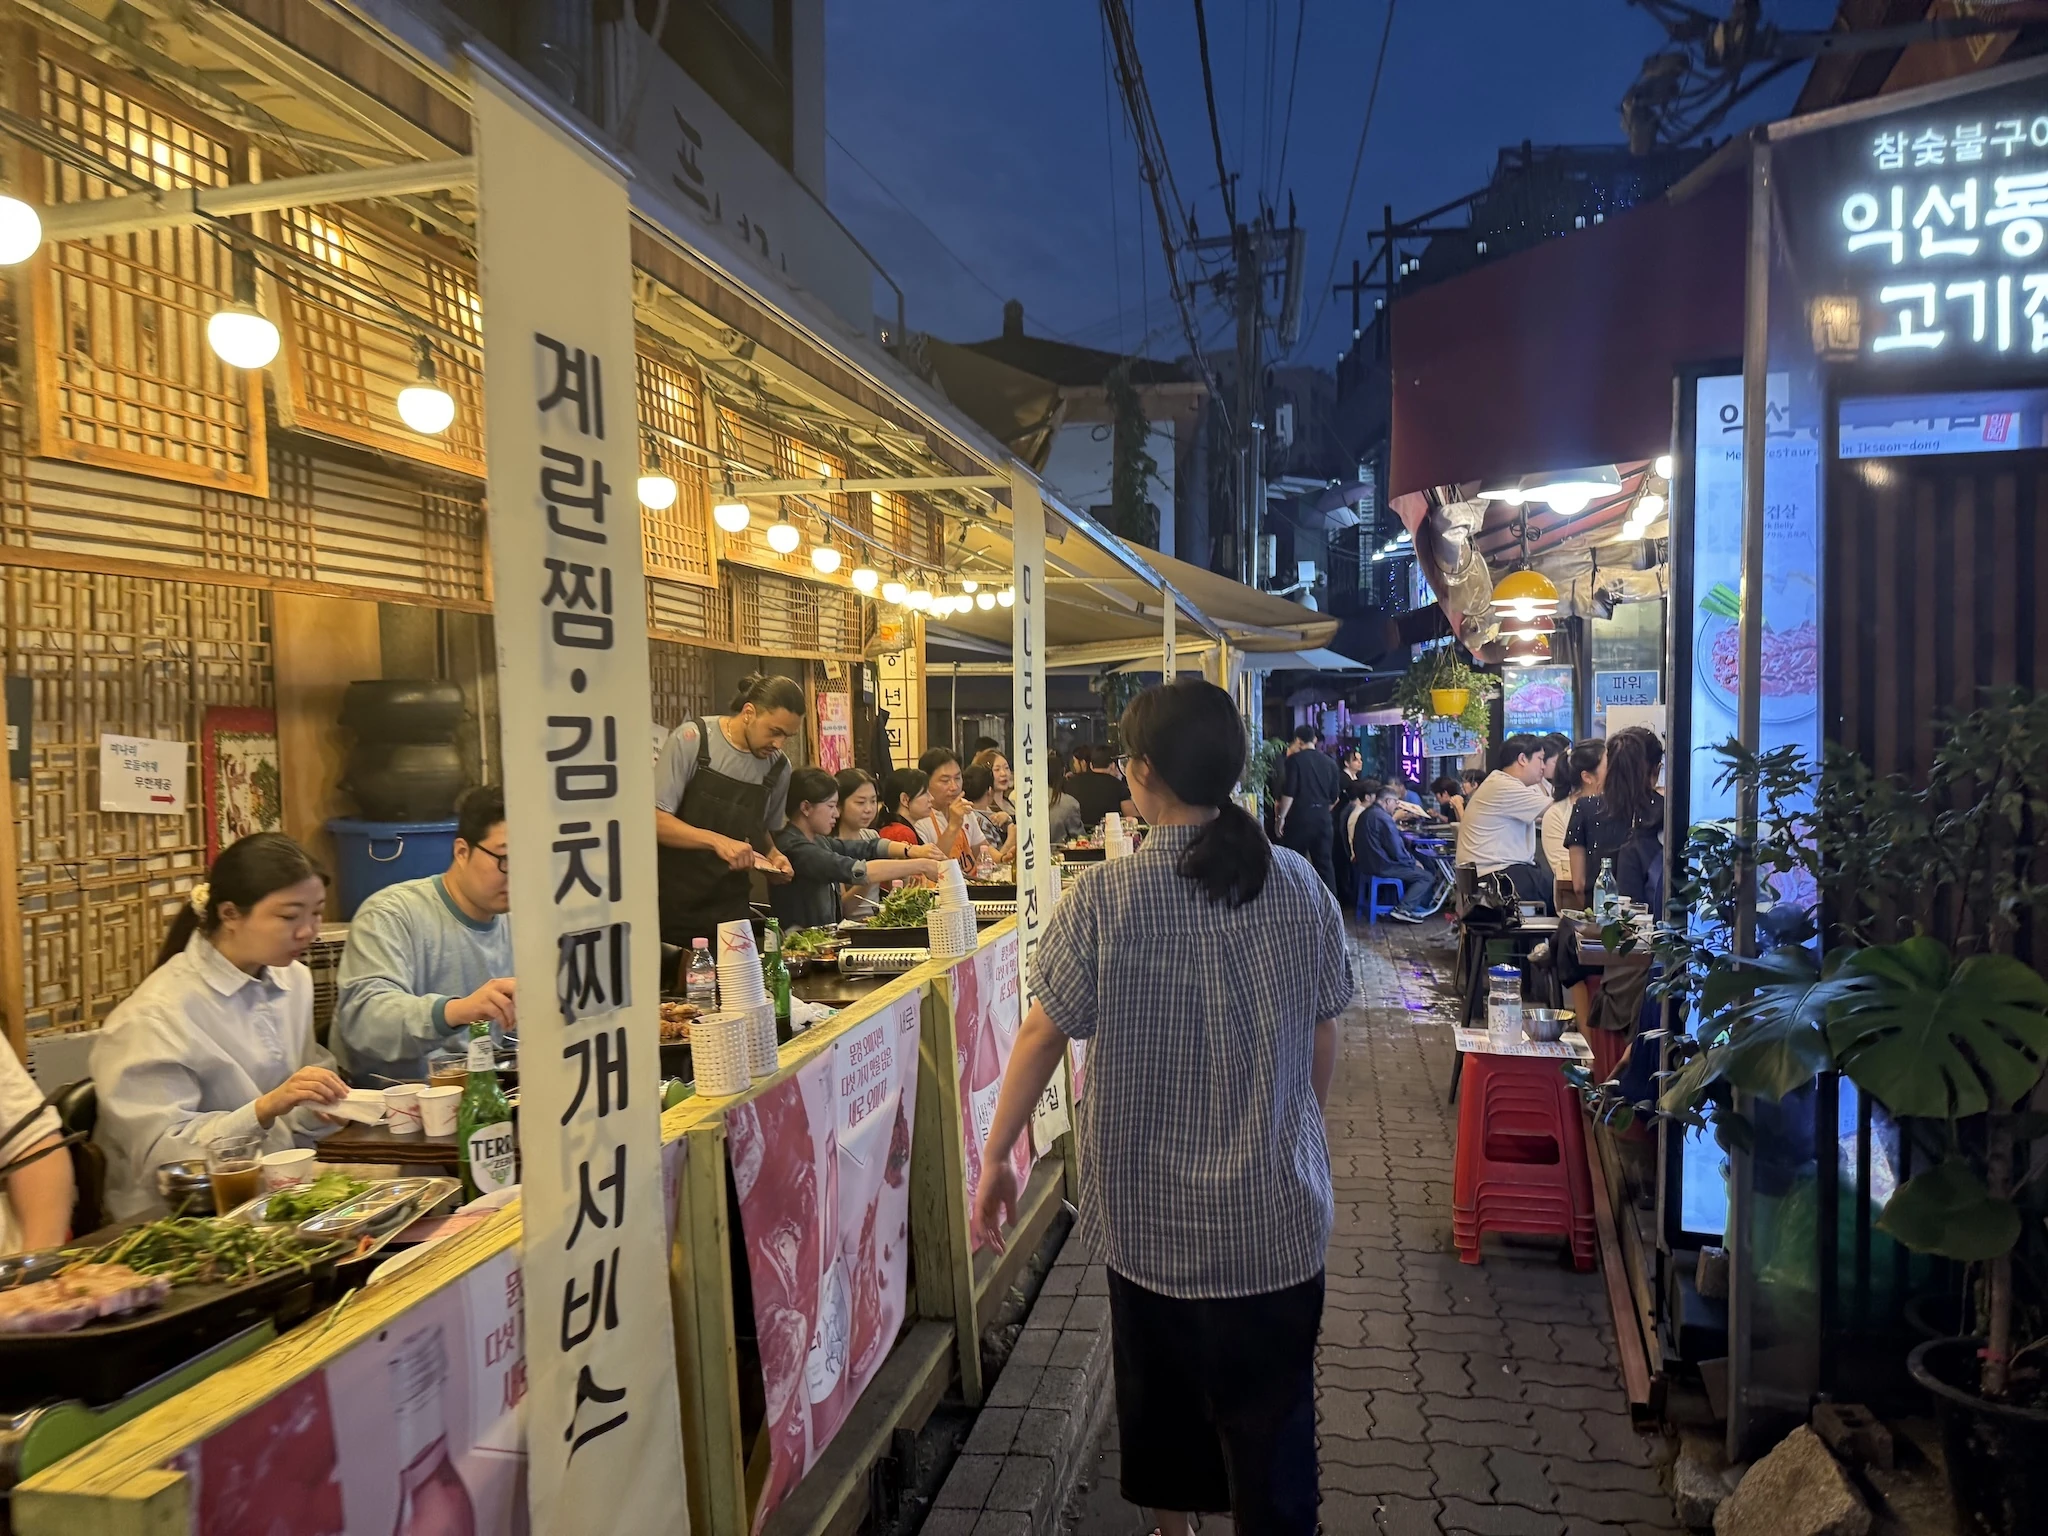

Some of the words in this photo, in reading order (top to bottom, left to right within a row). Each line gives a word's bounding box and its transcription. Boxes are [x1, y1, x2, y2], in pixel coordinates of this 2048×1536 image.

[1842, 171, 2048, 264] 익선동
[1858, 440, 1940, 453] Ikseon-dong
[1612, 675, 1642, 690] 파워
[110, 743, 138, 756] 미나리
[134, 776, 173, 791] 무한제공
[899, 1006, 914, 1036] 새로
[841, 1074, 856, 1096] 다섯
[857, 1065, 869, 1087] 가지
[848, 1095, 864, 1129] 새로
[866, 1078, 888, 1116] 오미자
